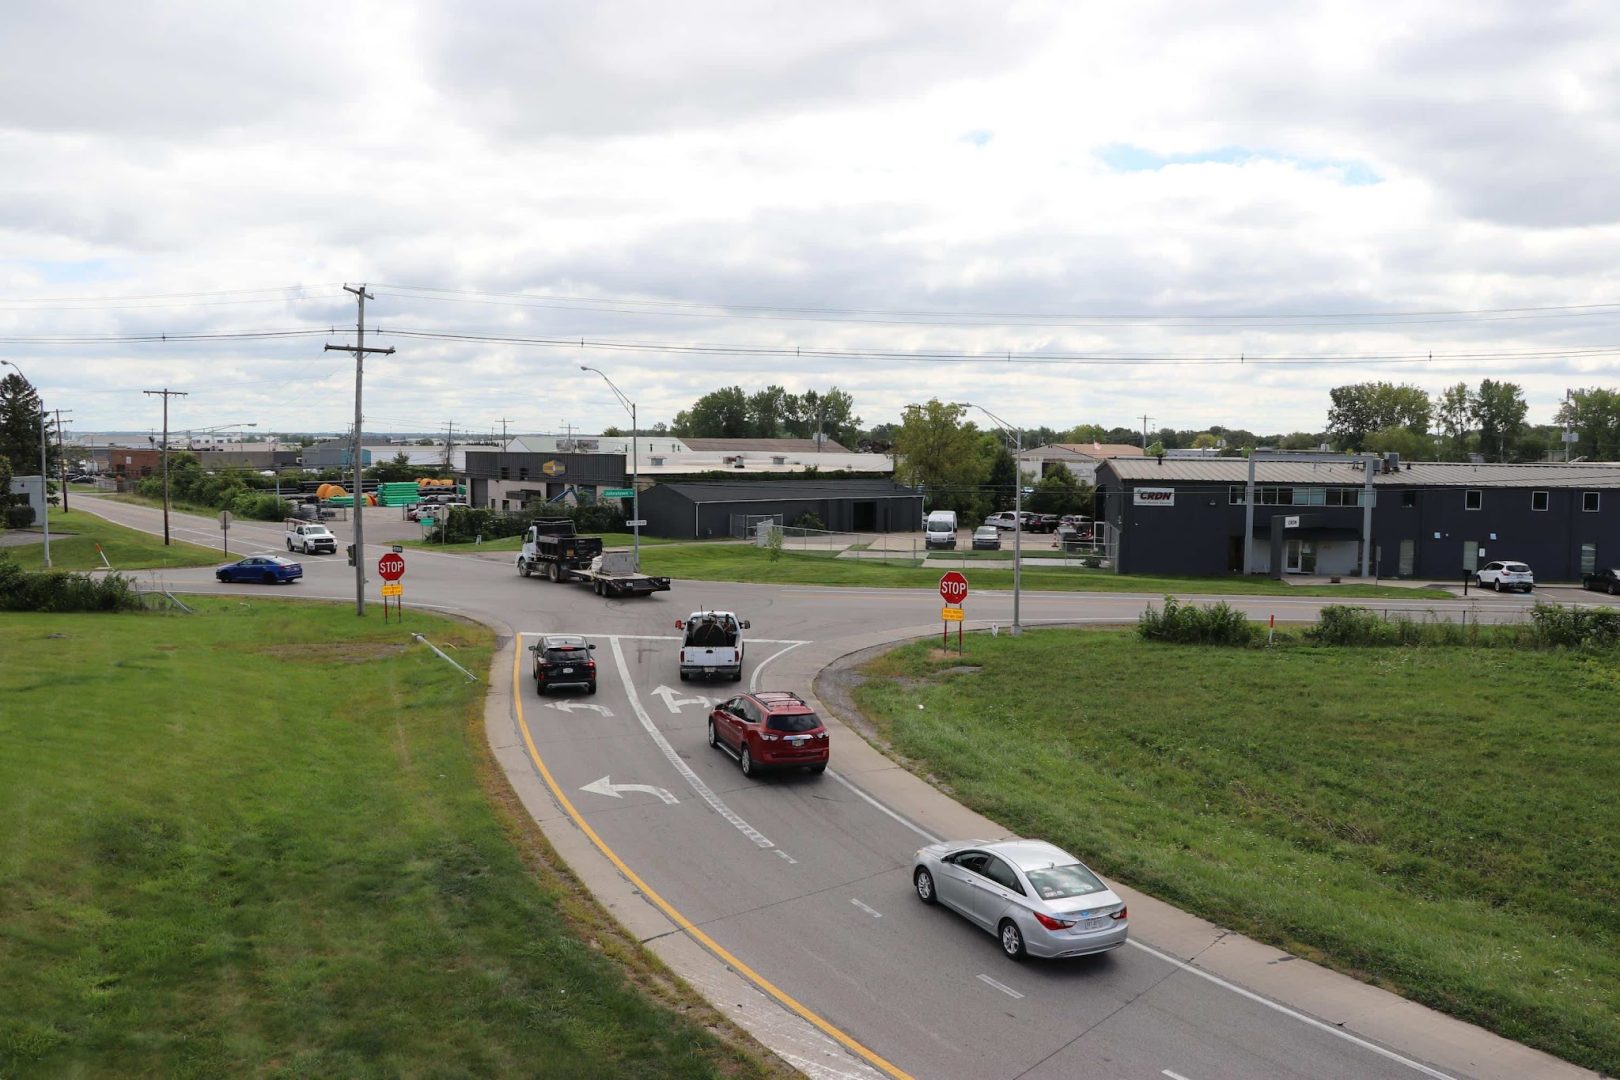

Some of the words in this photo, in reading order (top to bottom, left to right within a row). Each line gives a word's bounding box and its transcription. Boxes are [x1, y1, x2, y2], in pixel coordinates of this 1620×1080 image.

[1140, 491, 1172, 501] CRDN
[380, 561, 404, 573] STOP
[941, 581, 966, 595] STOP
